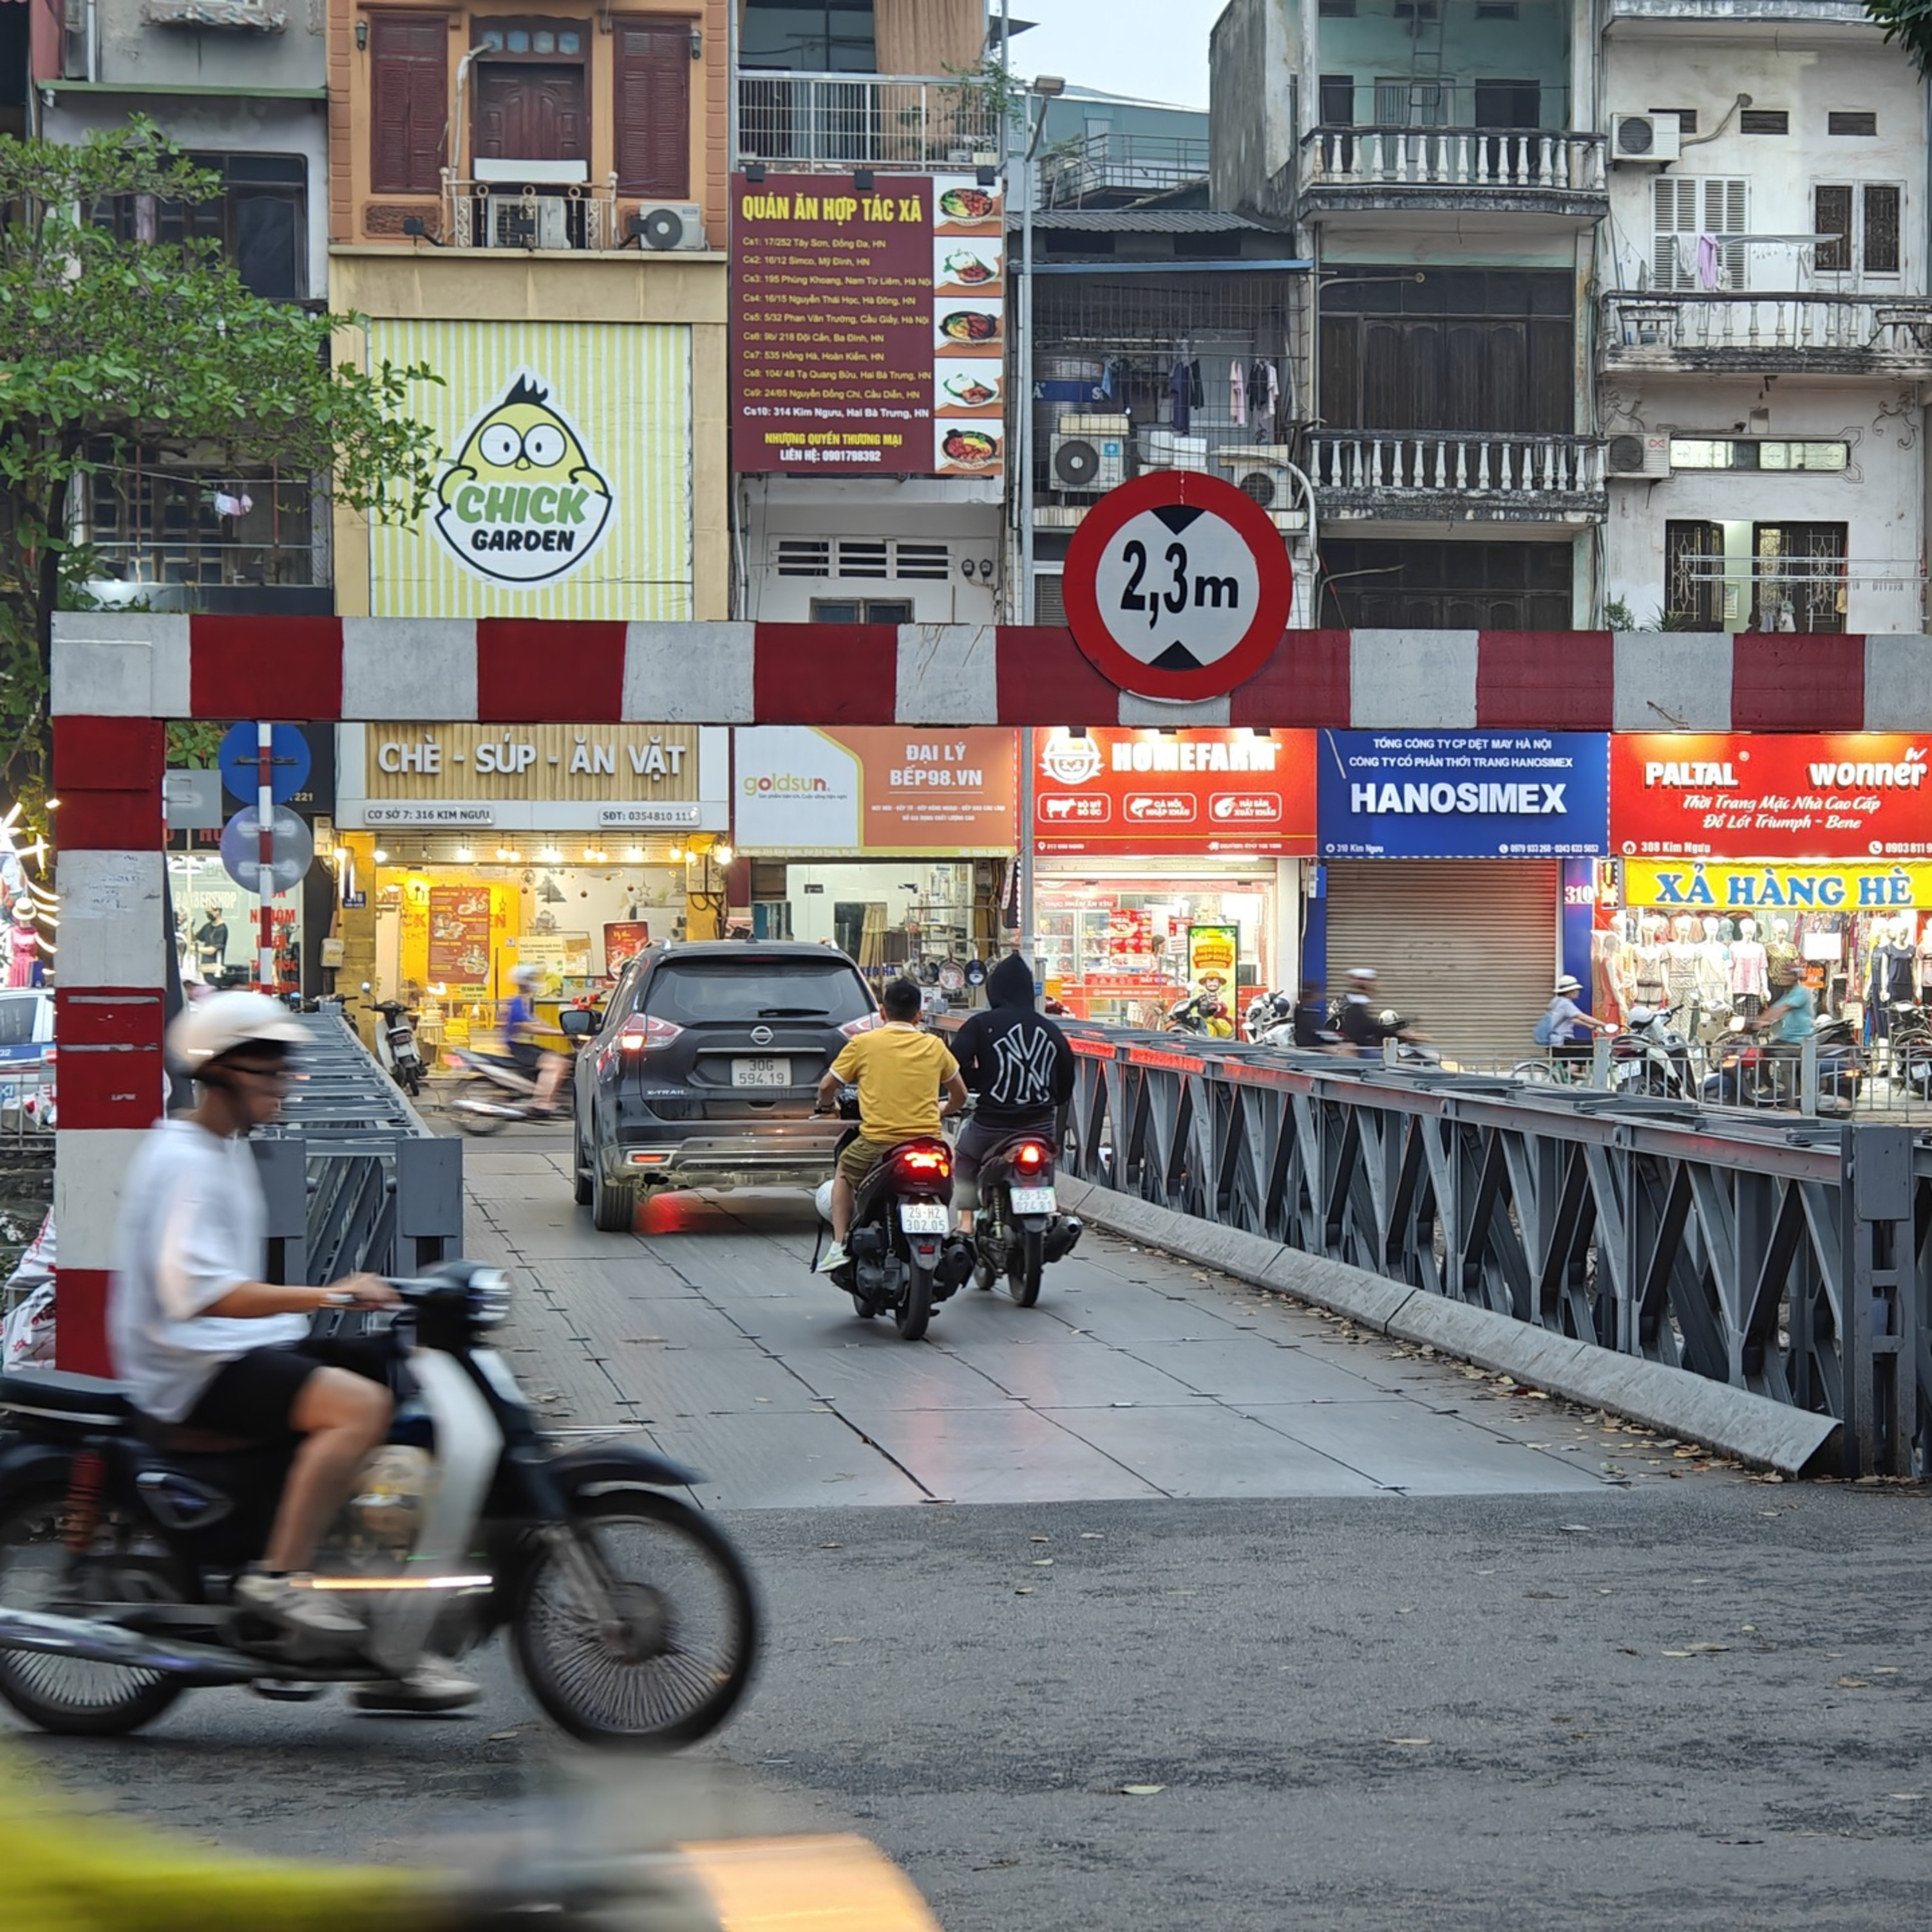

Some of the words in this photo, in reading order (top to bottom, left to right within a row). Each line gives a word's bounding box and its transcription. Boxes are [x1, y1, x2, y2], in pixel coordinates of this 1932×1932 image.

[742, 193, 790, 222] QUÁN
[793, 193, 818, 220] ĂN
[822, 197, 857, 226] HỢP
[861, 194, 894, 222] TÁC
[898, 195, 922, 222] XÃ
[743, 406, 770, 415] Cs10:
[773, 407, 791, 416] 314
[793, 408, 812, 416] Kim
[814, 408, 844, 419] Ngưu,
[846, 408, 862, 417] Hai
[880, 410, 912, 419] Trưng,
[882, 434, 902, 447] MẠI
[780, 448, 802, 461] LIÊN
[804, 448, 820, 463] HỆ:
[456, 486, 589, 524] CHICK
[471, 529, 575, 552] GARDEN
[1121, 540, 1238, 630] 2,3m
[906, 745, 938, 764] ĐẠI
[945, 742, 967, 761] LÝ
[1404, 738, 1434, 748] CÔNG
[1437, 739, 1450, 748] TY
[1452, 739, 1466, 748] CP
[1492, 739, 1512, 748] MAY
[1516, 738, 1530, 748] HÀ
[1533, 738, 1551, 750] NỘI
[378, 735, 440, 773] CHÈ
[475, 732, 537, 773] SÚP
[570, 735, 615, 774] ĂN
[627, 735, 686, 781] VẶT
[1349, 756, 1379, 766] CÔNG
[1381, 757, 1395, 766] TY
[1414, 755, 1443, 766] PHẦN
[1473, 757, 1509, 766] TRANG
[1511, 757, 1572, 767] HANOSIMEX
[890, 764, 983, 786] BẾP98.VN
[1645, 761, 1739, 787] PALTAL
[743, 773, 828, 796] goldsun
[1351, 783, 1567, 814] HANOSIMEX
[1683, 795, 1712, 810] Thời
[1715, 795, 1756, 813] Trang
[1757, 795, 1790, 812] Mặc
[1792, 796, 1823, 810] Nhà
[1824, 797, 1852, 810] Cao
[1852, 795, 1880, 813] Cấp
[368, 810, 383, 819] CƠ
[385, 810, 400, 819] SỞ
[403, 810, 412, 819] 7:
[415, 810, 433, 819] 316
[437, 810, 457, 819] KIM
[460, 810, 489, 819] NGƯU
[603, 811, 625, 820] SĐT:
[1703, 813, 1725, 828] Đồ
[1728, 815, 1751, 828] Lót
[1755, 814, 1812, 832] Triumph
[1824, 815, 1862, 829] Bene
[1642, 842, 1660, 851] 308
[1662, 842, 1681, 852] Kim
[1684, 842, 1710, 853] Ngưu
[1886, 842, 1909, 853] 0903
[1910, 842, 1924, 853] 811
[1656, 863, 1714, 904] XẢ
[1728, 867, 1846, 905] HÀNG
[1859, 867, 1913, 904] HÈ
[175, 891, 237, 909] BABERSHOP
[1565, 886, 1593, 904] 310
[748, 1059, 774, 1071] 30G
[739, 1073, 785, 1085] 594.19
[908, 1207, 940, 1219] 29-H2
[905, 1220, 946, 1231] 302.05
